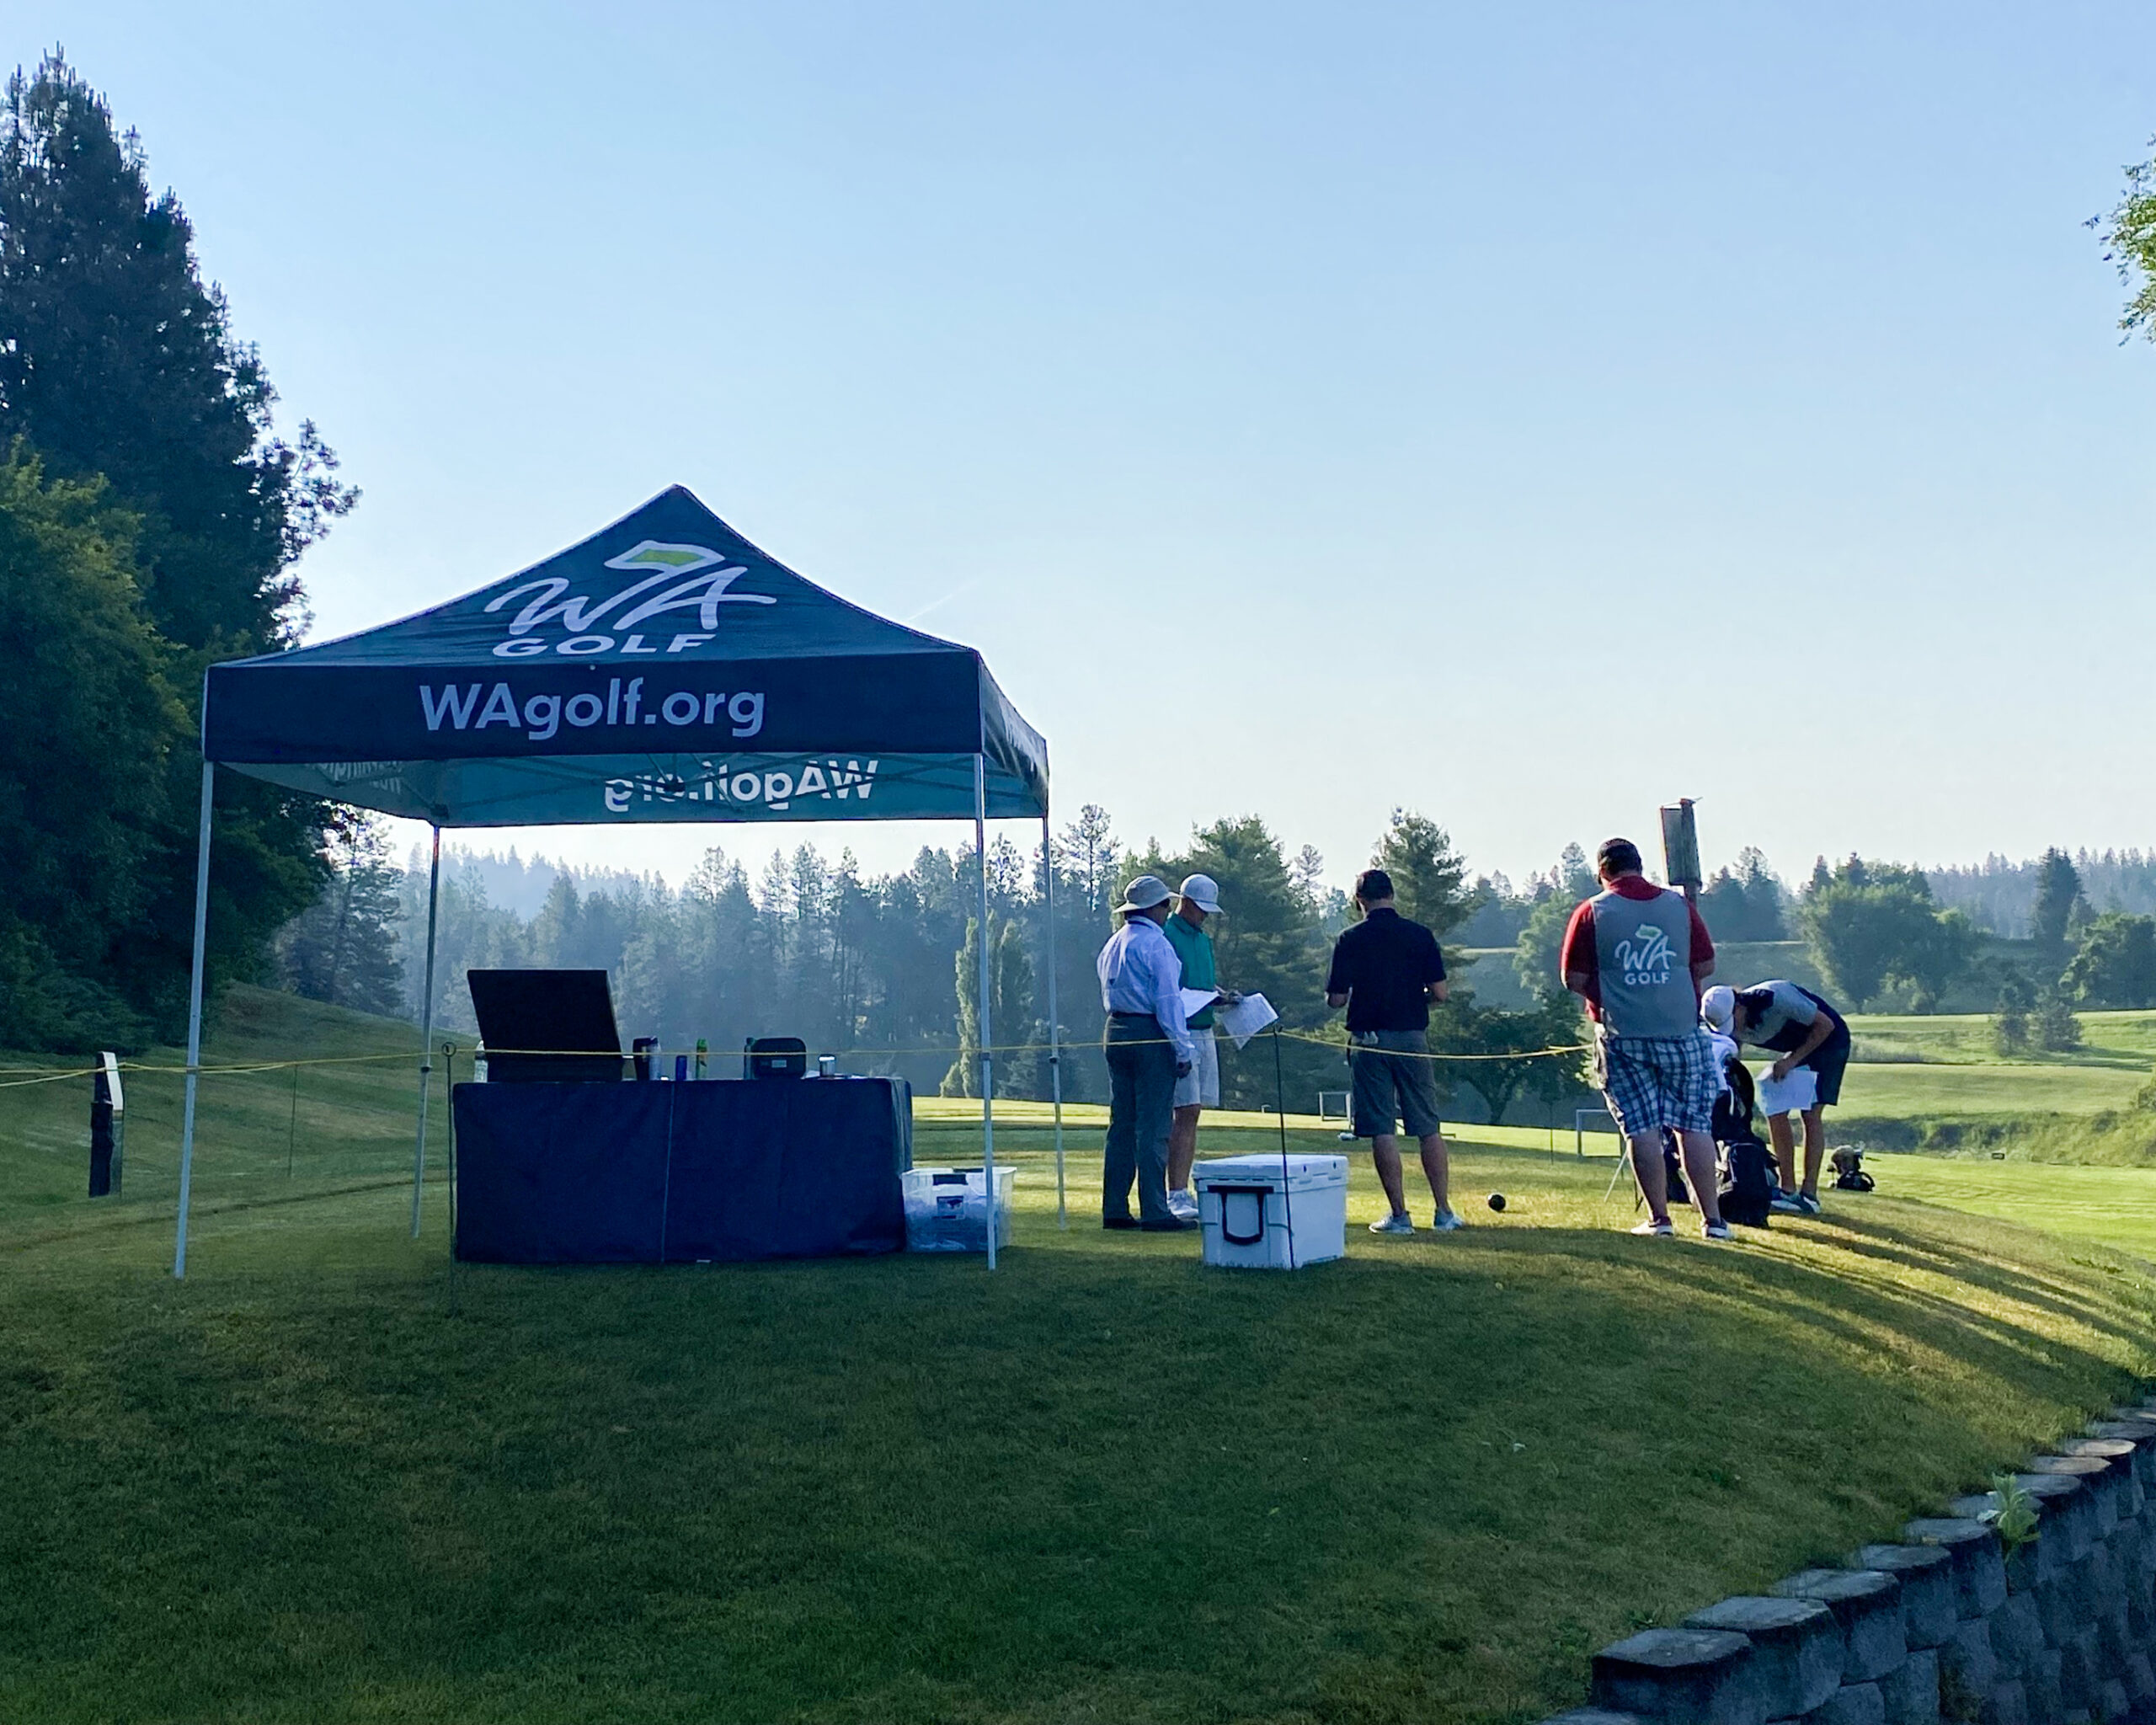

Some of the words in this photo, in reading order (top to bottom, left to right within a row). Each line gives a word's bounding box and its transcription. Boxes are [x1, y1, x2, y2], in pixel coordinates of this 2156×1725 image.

[493, 633, 717, 657] GOLF
[419, 677, 765, 740] WAgolf.org
[1625, 972, 1670, 985] GOLF
